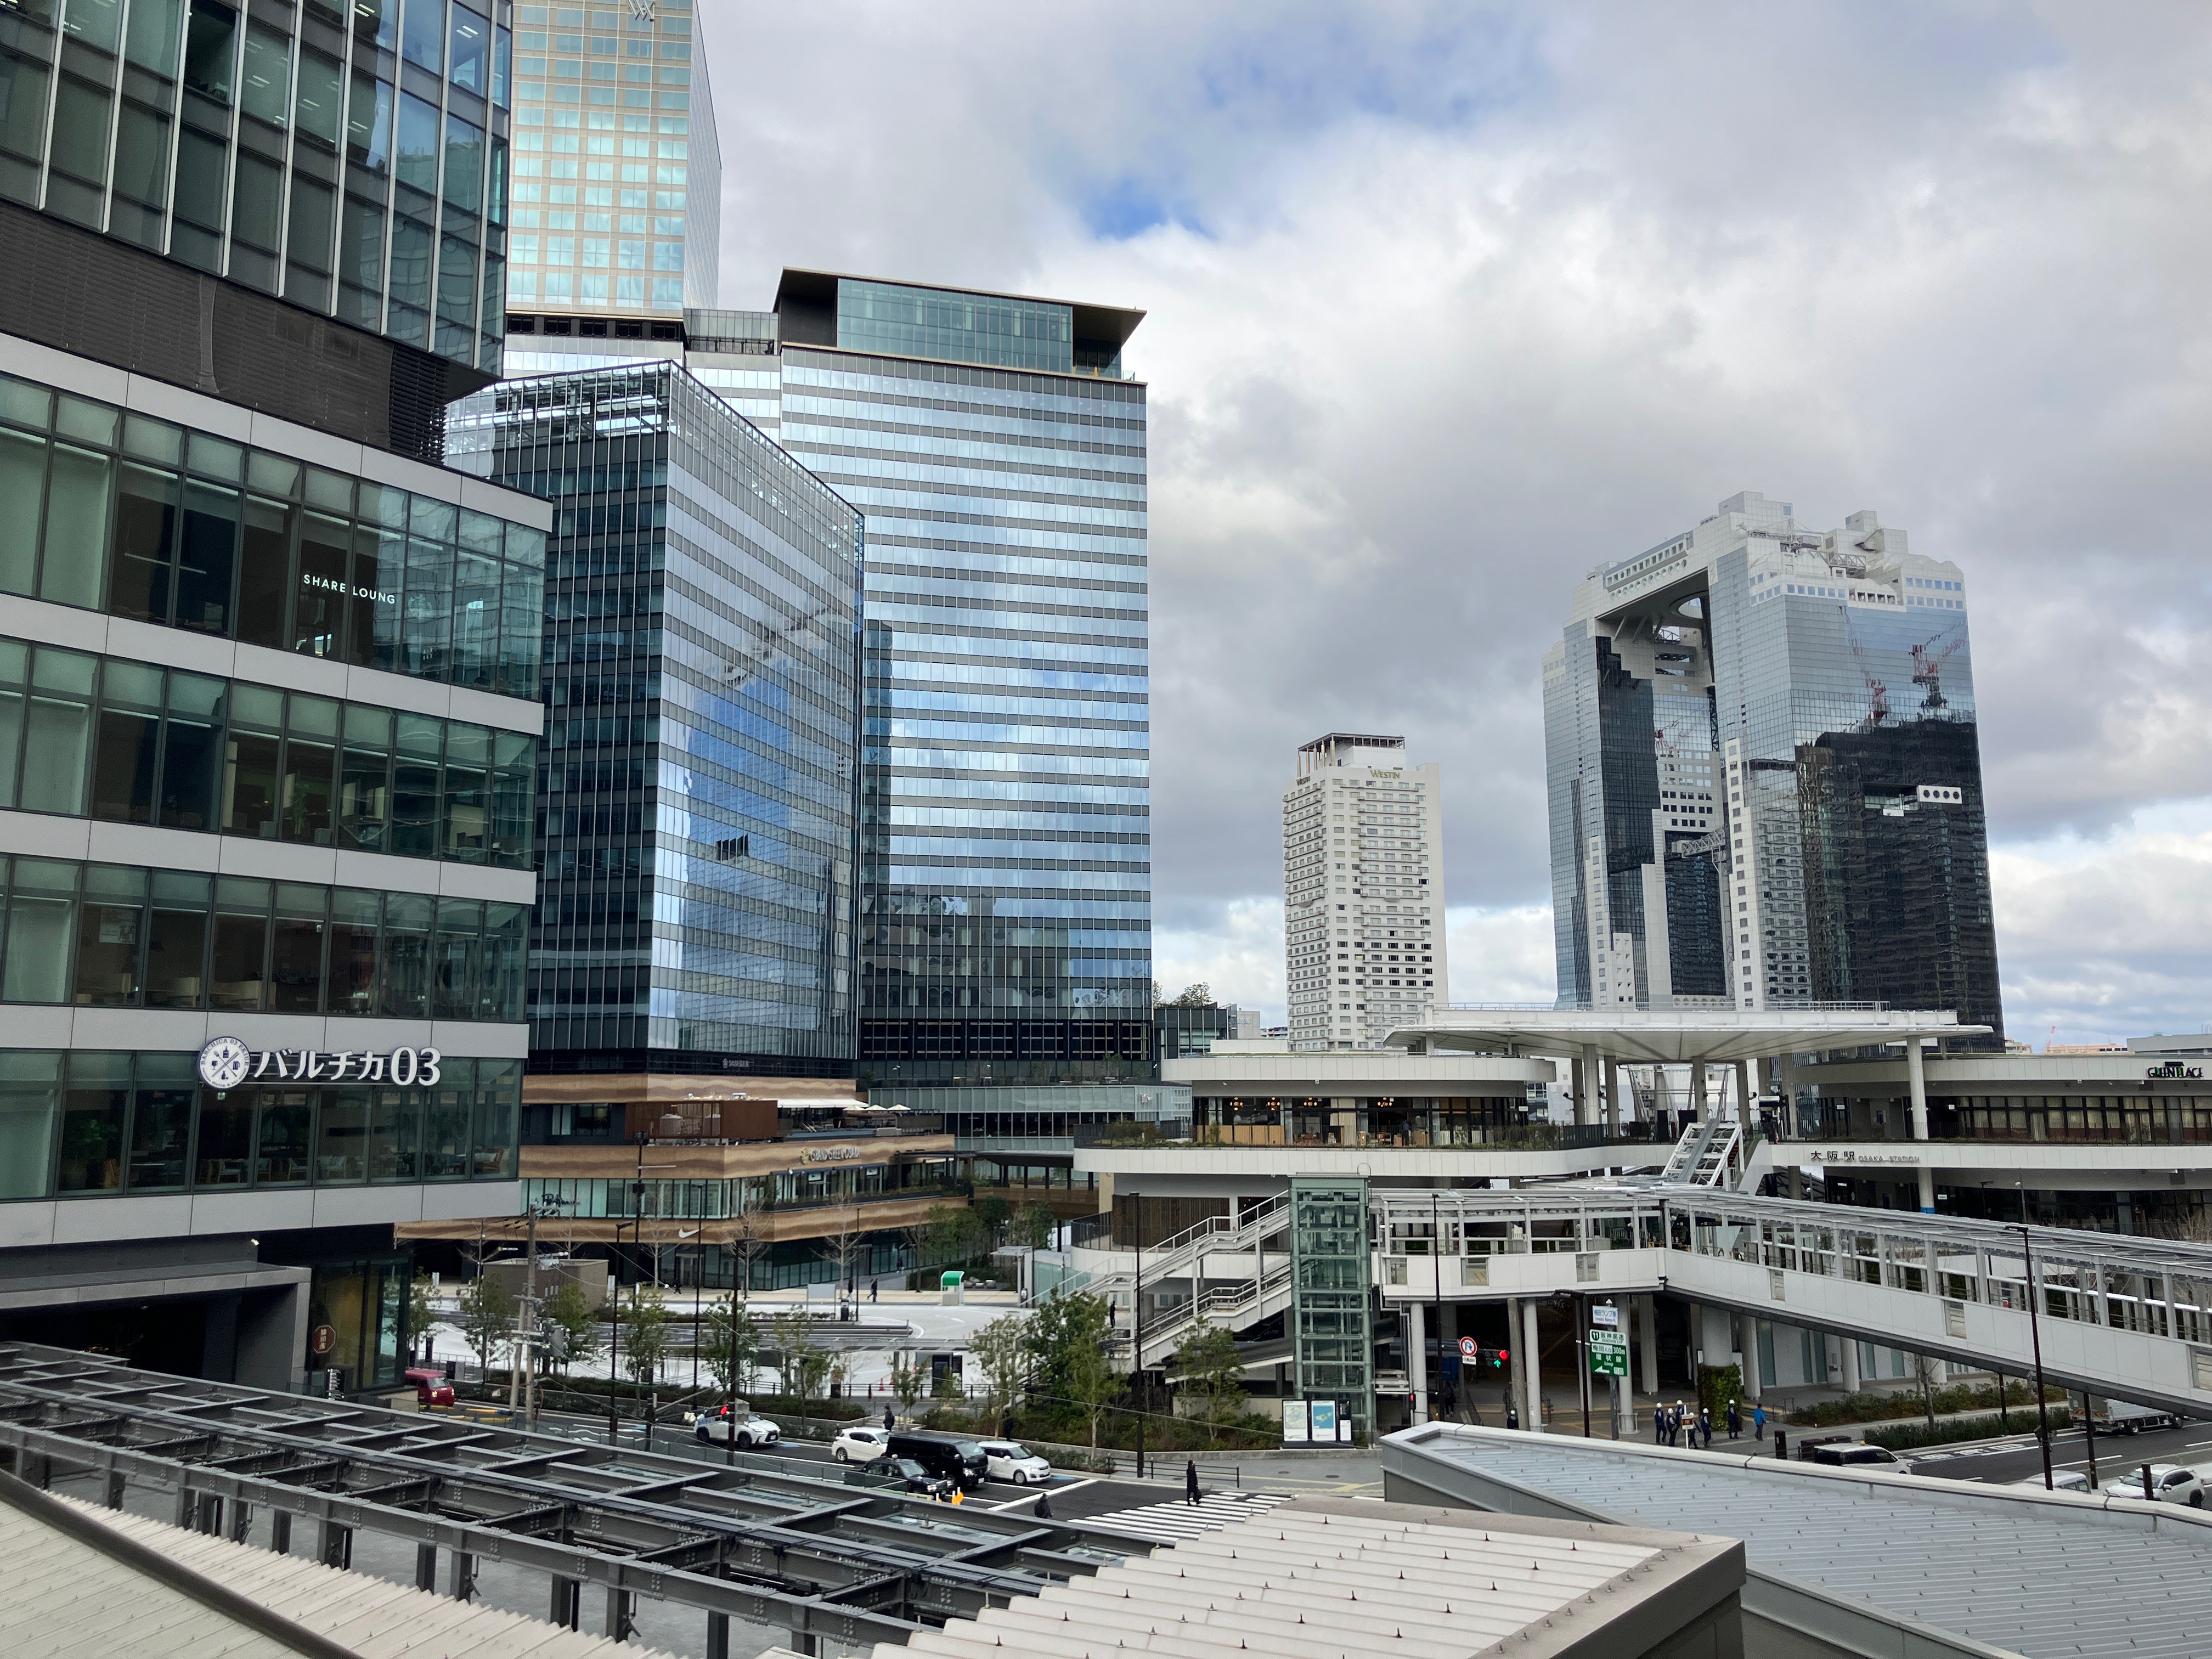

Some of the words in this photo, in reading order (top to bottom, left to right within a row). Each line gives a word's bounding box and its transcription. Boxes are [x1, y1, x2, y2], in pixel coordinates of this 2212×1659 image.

[304, 574, 347, 593] SHARE
[1296, 776, 1310, 786] WESTIN
[1370, 770, 1400, 779] WESTIN
[201, 1039, 228, 1065] BARCHICA
[253, 1046, 441, 1086] バルチカ03
[1811, 1150, 1855, 1161] 大阪駅
